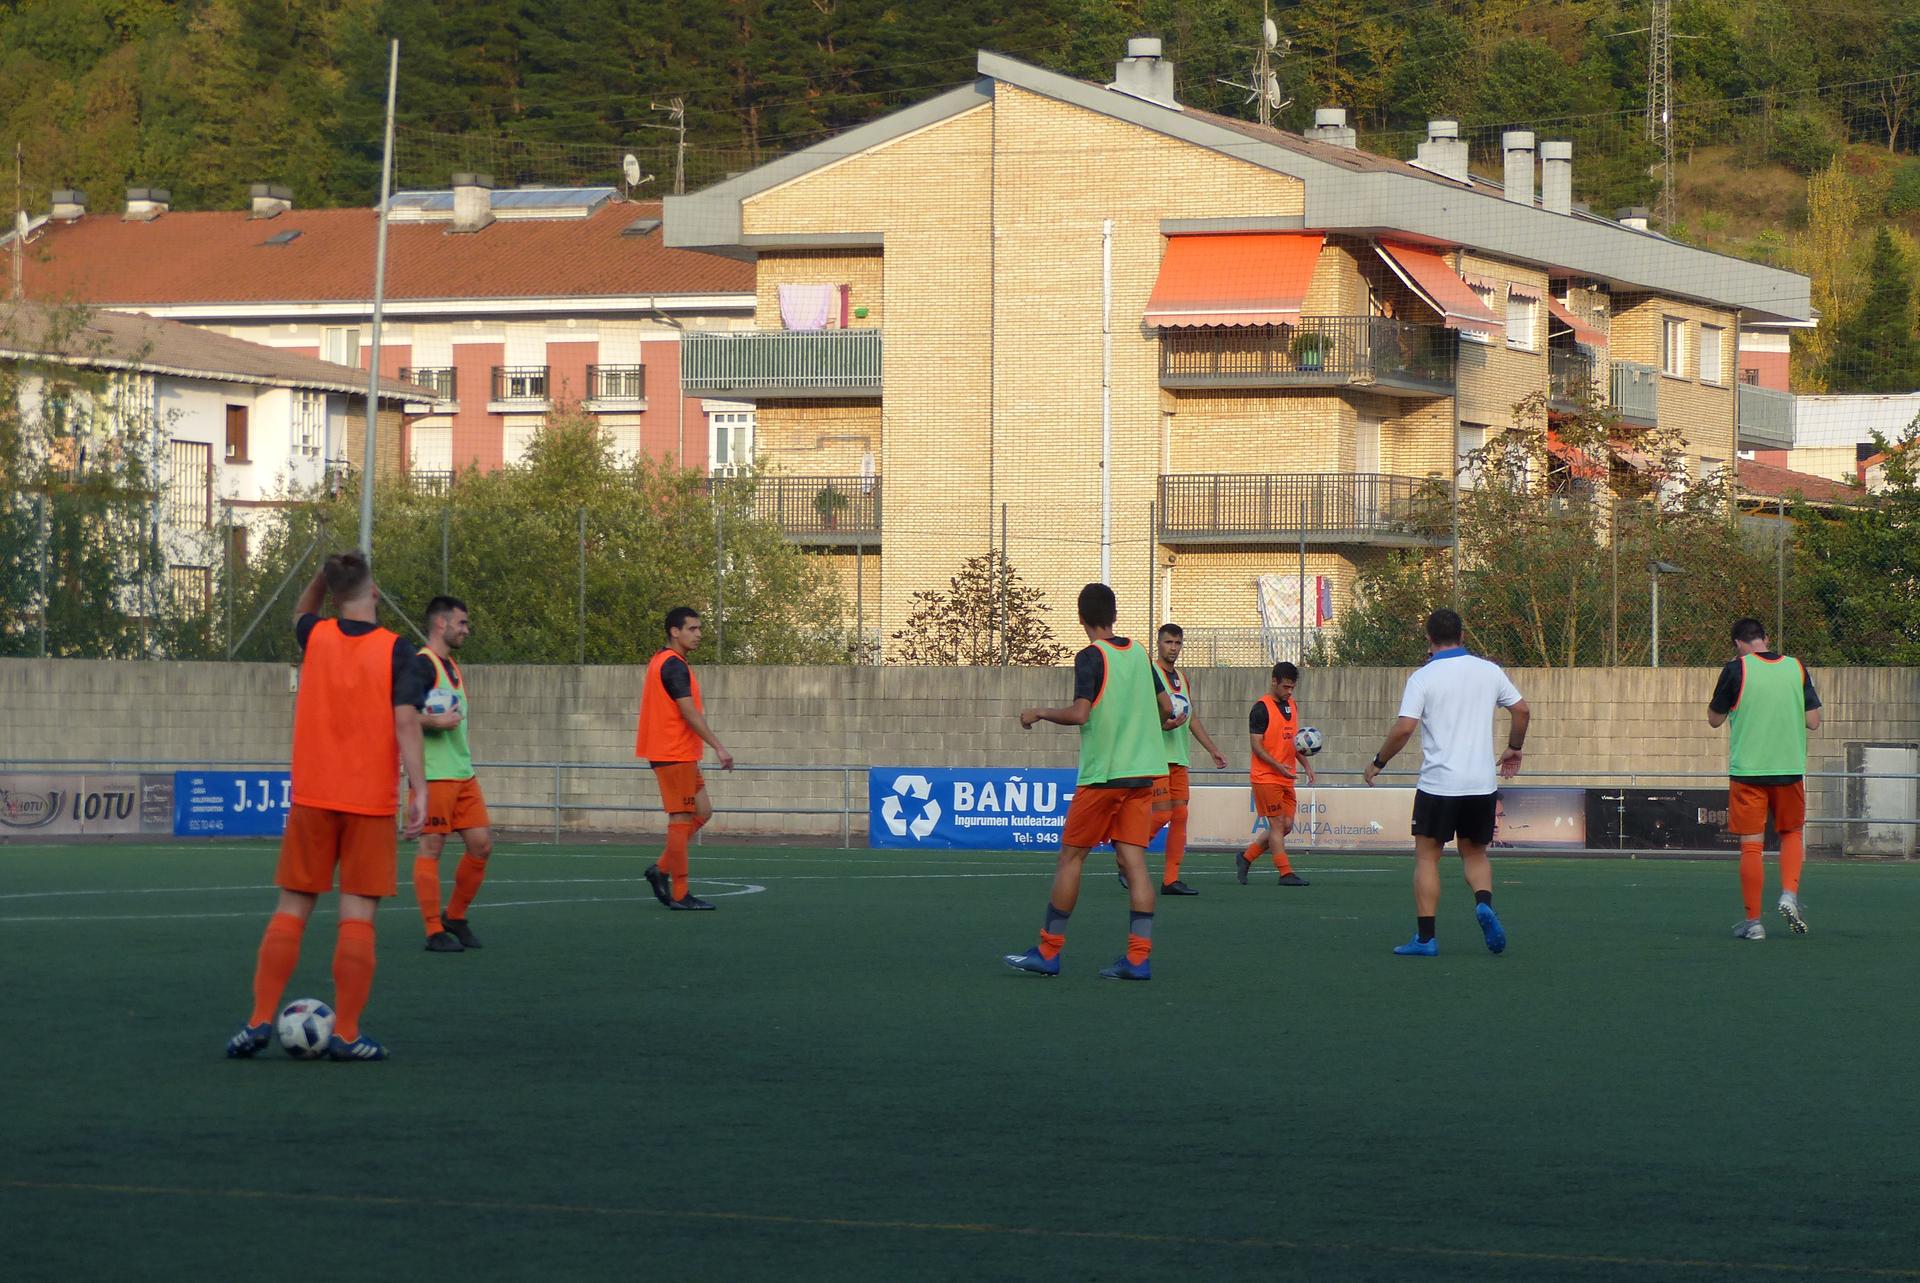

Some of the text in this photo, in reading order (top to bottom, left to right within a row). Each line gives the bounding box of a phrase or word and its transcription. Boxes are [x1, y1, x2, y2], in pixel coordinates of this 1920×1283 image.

[954, 814, 1009, 828] Ingurumen
[1334, 822, 1380, 835] altzariak
[1012, 832, 1059, 843] Tel: 943
